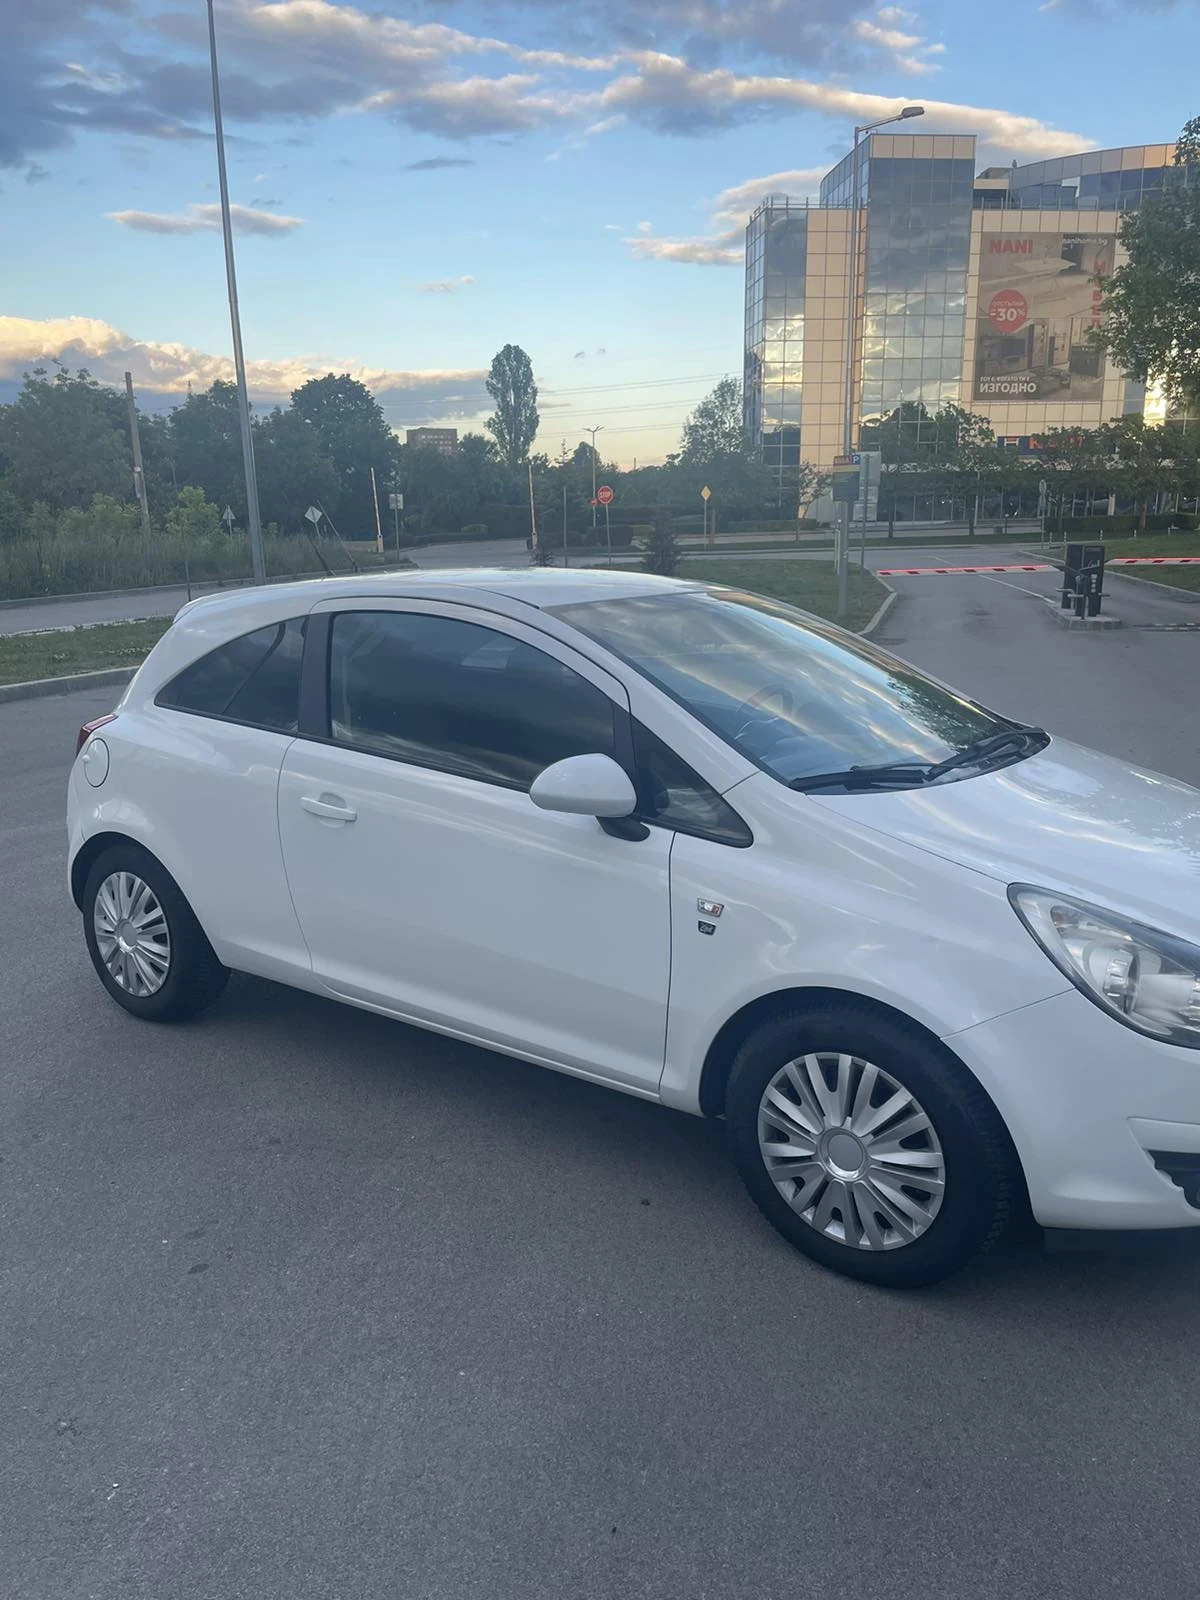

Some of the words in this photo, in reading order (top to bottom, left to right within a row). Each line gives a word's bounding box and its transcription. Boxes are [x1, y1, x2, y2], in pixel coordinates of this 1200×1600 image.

[990, 239, 1033, 254] NANI
[990, 308, 1026, 322] -30%
[979, 383, 1037, 394] ИЗГОДНО
[852, 455, 860, 464] P
